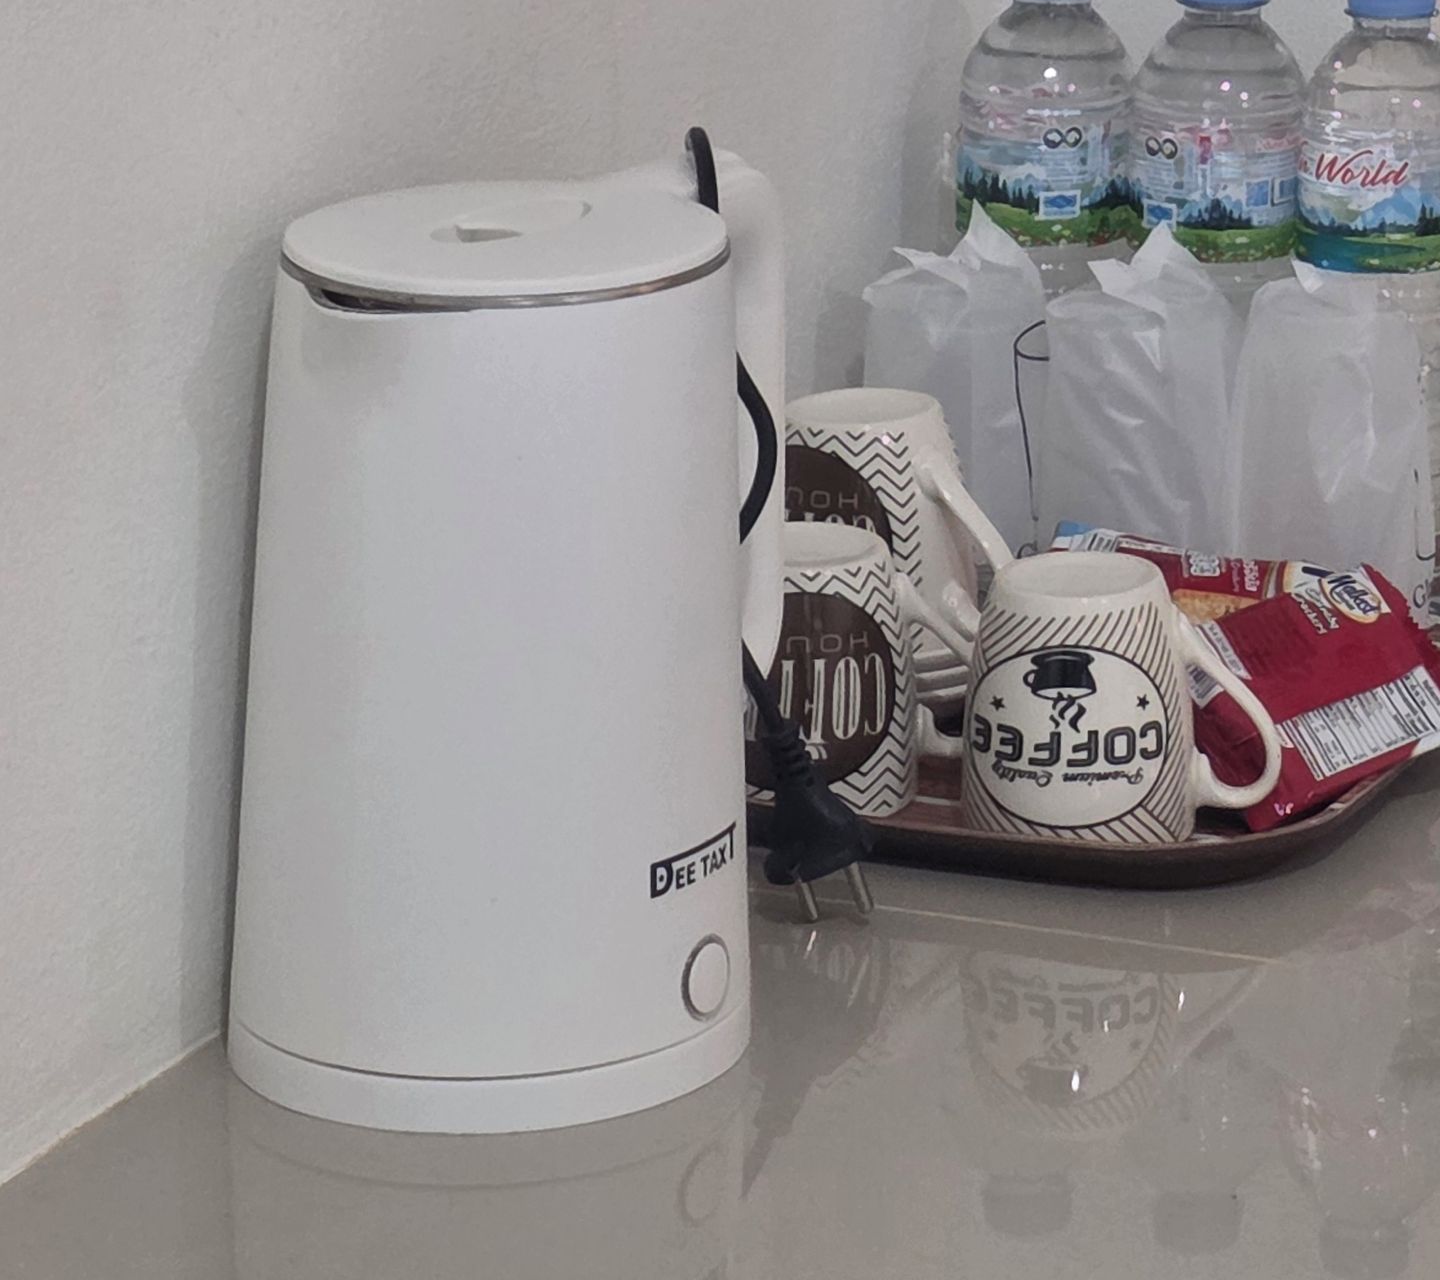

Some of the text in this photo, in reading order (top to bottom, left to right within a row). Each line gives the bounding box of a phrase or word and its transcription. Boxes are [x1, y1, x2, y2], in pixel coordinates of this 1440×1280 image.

[1315, 149, 1409, 188] World
[972, 713, 1164, 768] COFFEE
[991, 759, 1145, 788] Premium Quality
[650, 848, 696, 899] DEE
